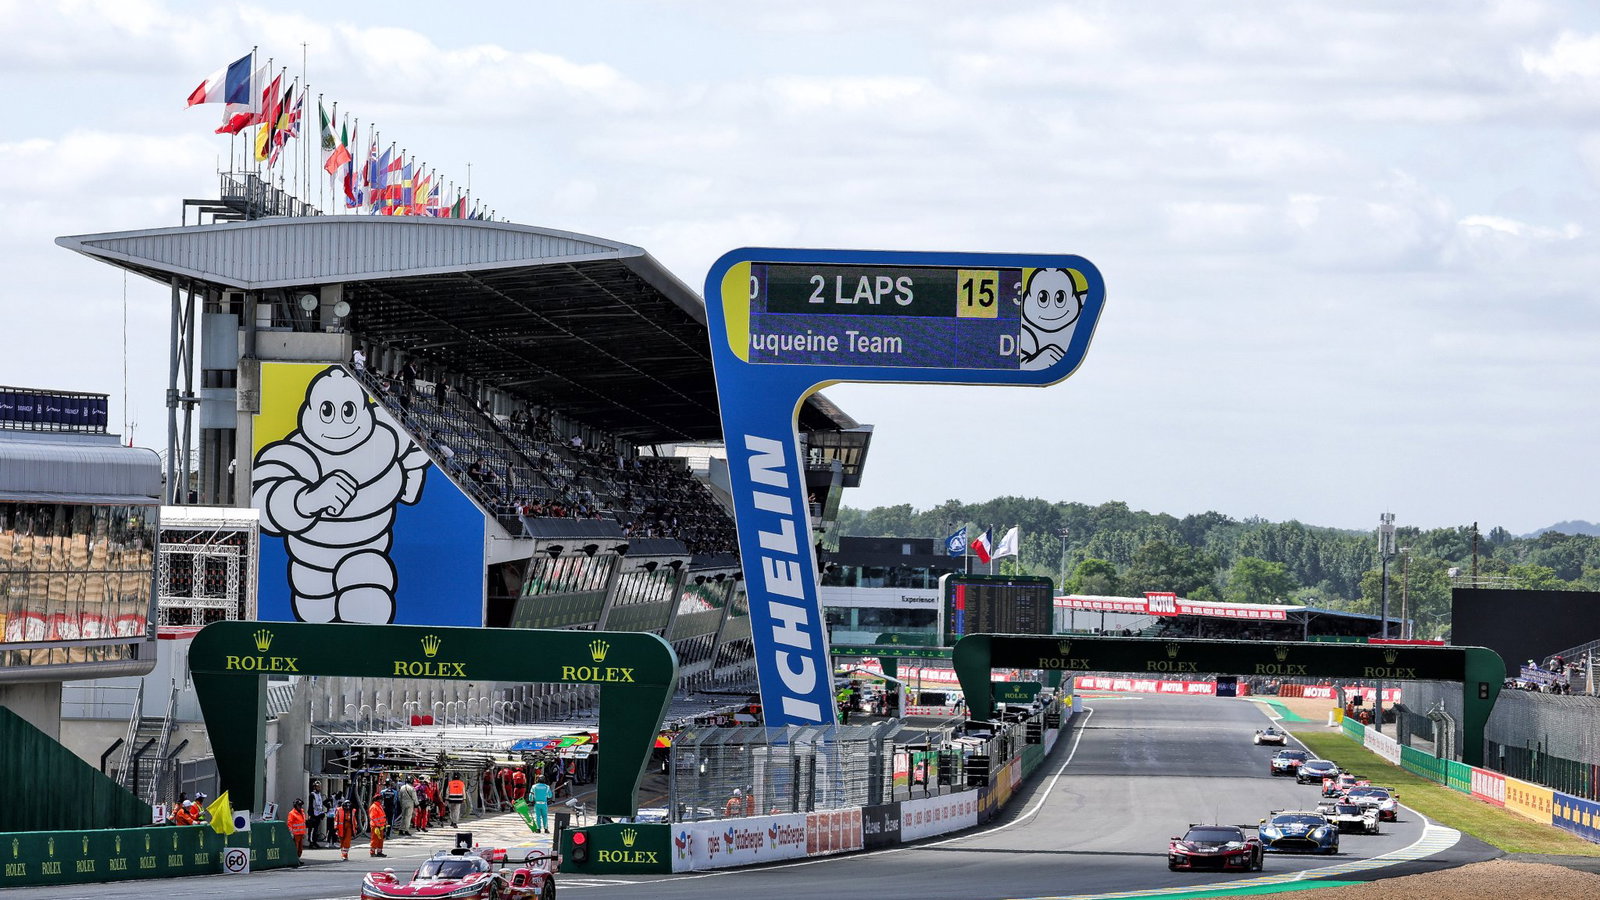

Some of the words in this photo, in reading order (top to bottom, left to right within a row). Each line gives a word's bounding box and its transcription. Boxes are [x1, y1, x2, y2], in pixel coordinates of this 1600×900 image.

[808, 274, 825, 304] 2
[835, 275, 914, 306] LAPS
[962, 277, 995, 308] 15
[749, 329, 839, 356] uqueine
[845, 330, 903, 353] Team
[901, 595, 935, 604] Experience
[1148, 595, 1176, 613] MOTUL
[226, 655, 299, 672] ROLEX
[393, 660, 467, 677] ROLEX
[1039, 657, 1090, 670] ROLEX
[1147, 660, 1198, 672] ROLEX
[1255, 663, 1307, 675] ROLEX
[561, 665, 635, 683] ROLEX
[1363, 666, 1416, 679] ROLEX
[1161, 683, 1184, 692] MOTUL
[1188, 683, 1213, 693] MOTUL
[1303, 687, 1332, 697] MOTUL
[1004, 692, 1029, 700] ROLEX
[109, 857, 127, 871] ROLEX
[140, 856, 157, 869] ROLEX
[228, 855, 245, 867] 60
[598, 850, 659, 864] ROLEX
[5, 863, 27, 877] ROLEX
[41, 861, 62, 875] ROLEX
[76, 859, 96, 873] ROLEX
